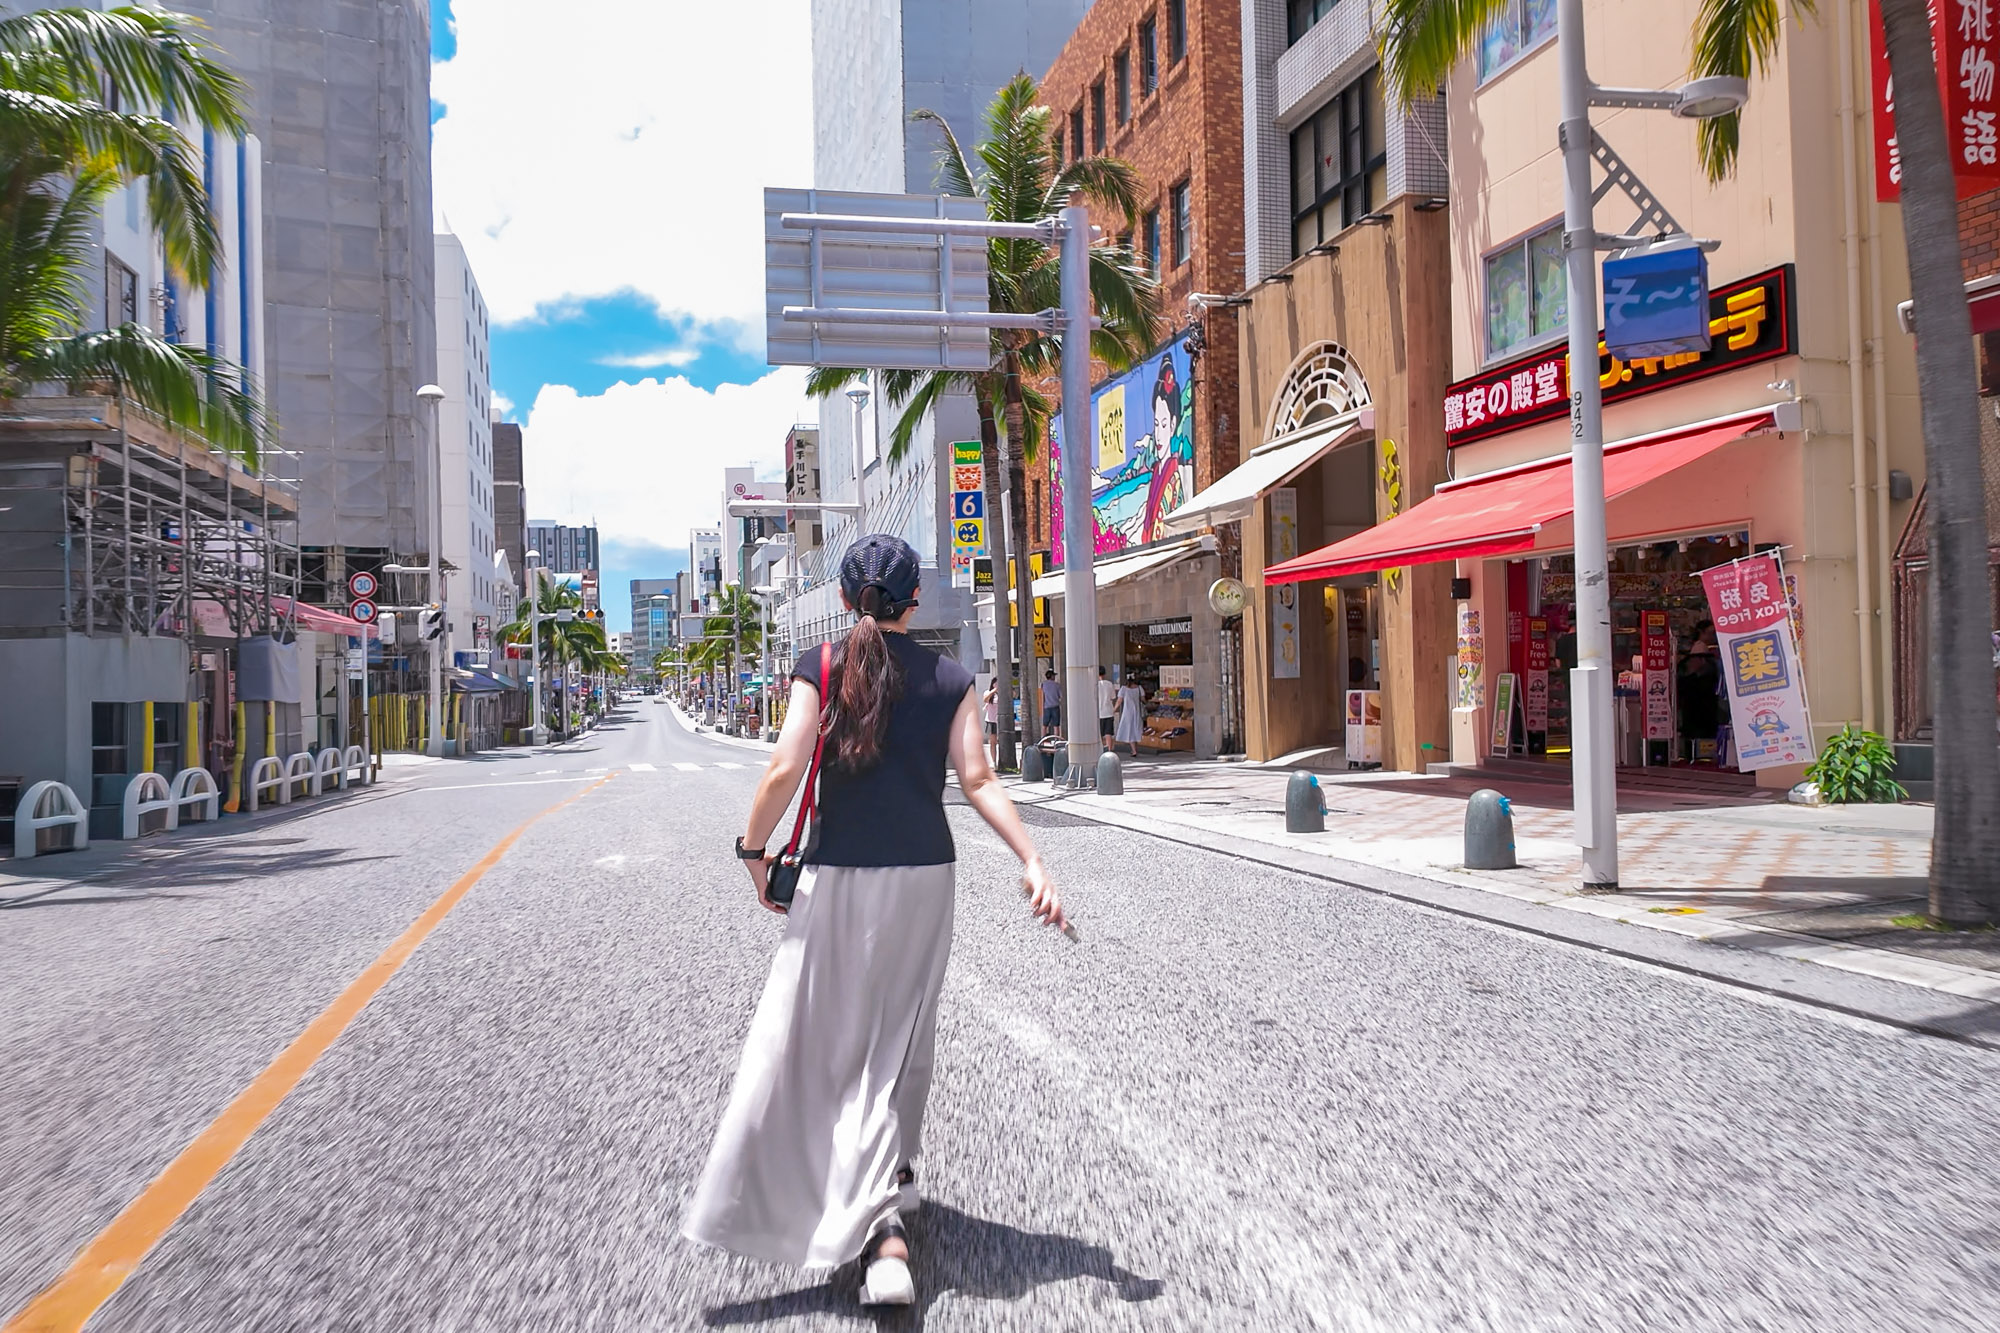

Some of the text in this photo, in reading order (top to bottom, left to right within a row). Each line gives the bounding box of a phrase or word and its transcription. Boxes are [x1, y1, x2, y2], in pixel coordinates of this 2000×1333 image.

[1444, 361, 1559, 433] 驚安の殿堂
[1574, 391, 1583, 438] 942
[955, 448, 981, 460] happy
[962, 495, 976, 516] 6
[976, 571, 992, 579] Jazz
[356, 579, 371, 591] 30
[1532, 641, 1545, 649] Tax
[1649, 637, 1665, 647] Tax
[1530, 650, 1547, 658] Free
[1647, 647, 1666, 656] Free
